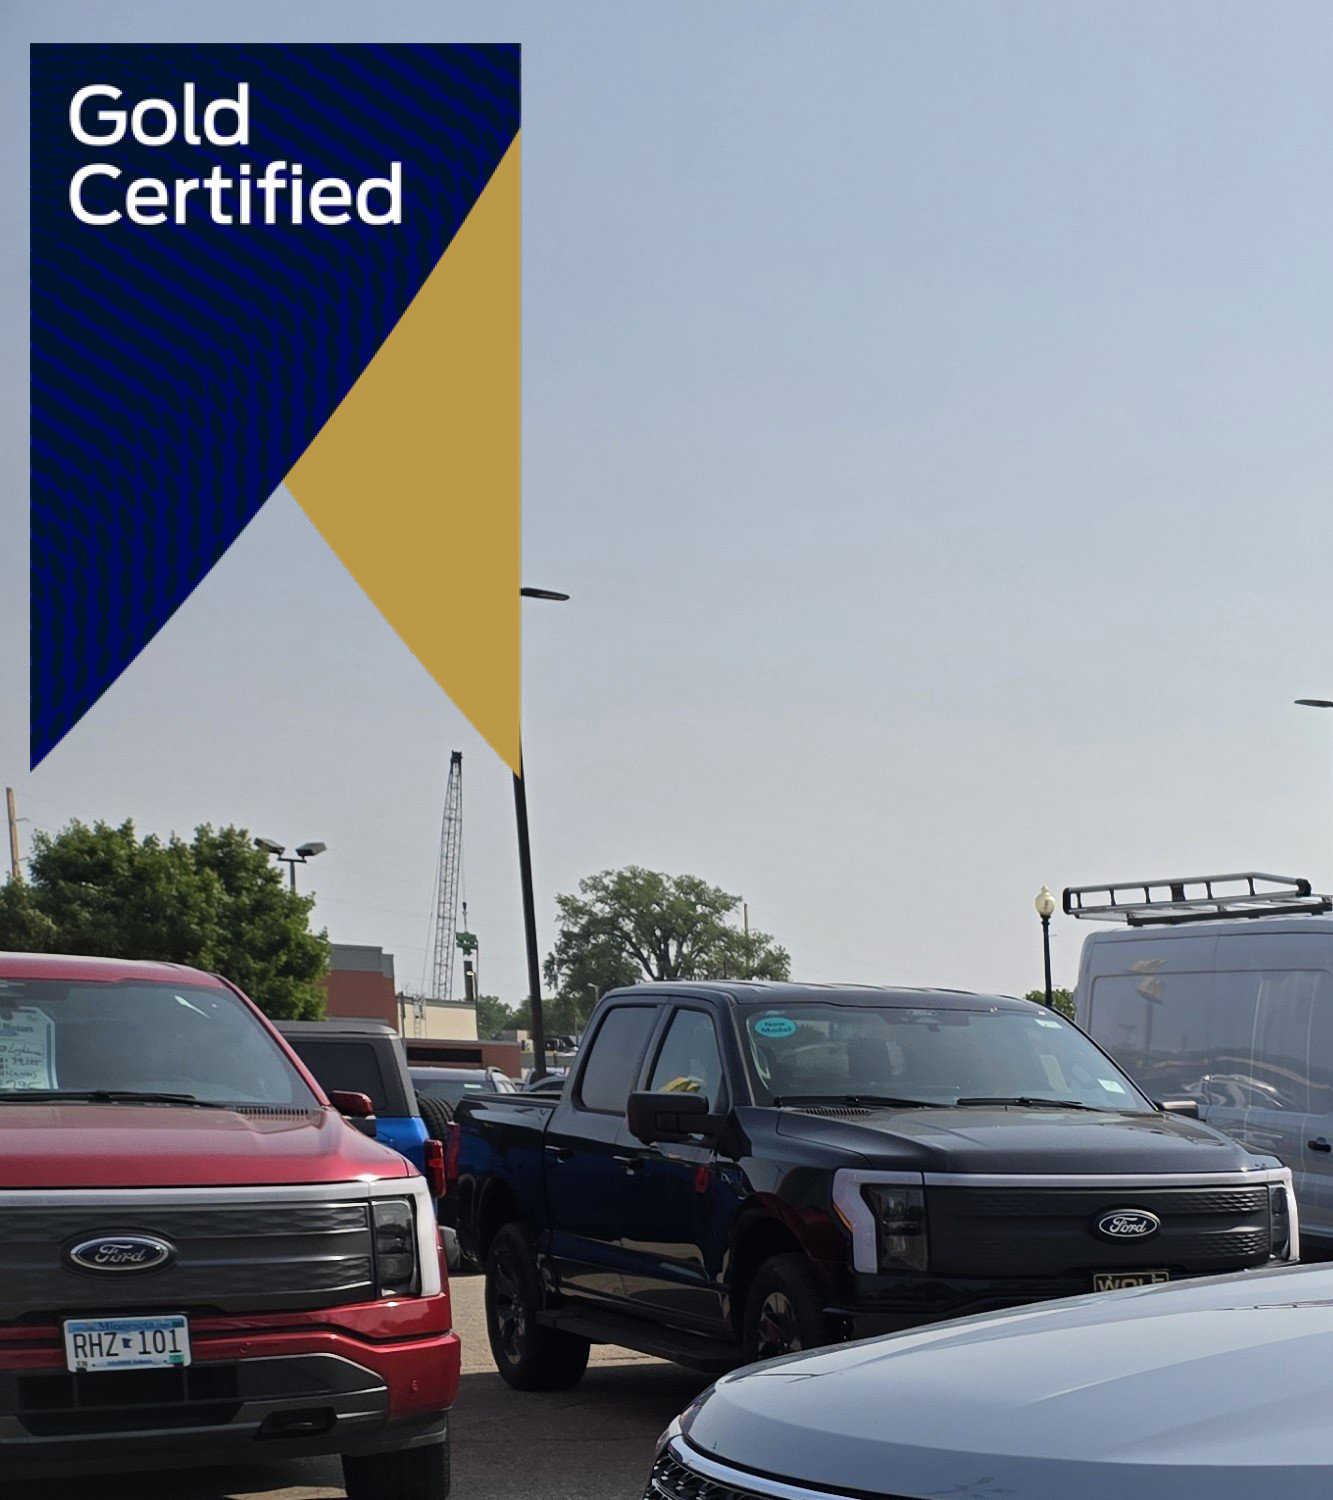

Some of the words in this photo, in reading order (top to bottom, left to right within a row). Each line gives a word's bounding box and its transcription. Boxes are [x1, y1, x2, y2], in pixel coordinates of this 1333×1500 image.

[1109, 1216, 1147, 1233] Ford
[94, 1244, 146, 1263] Ford
[73, 1332, 119, 1358] RHZ
[138, 1329, 182, 1355] 101
